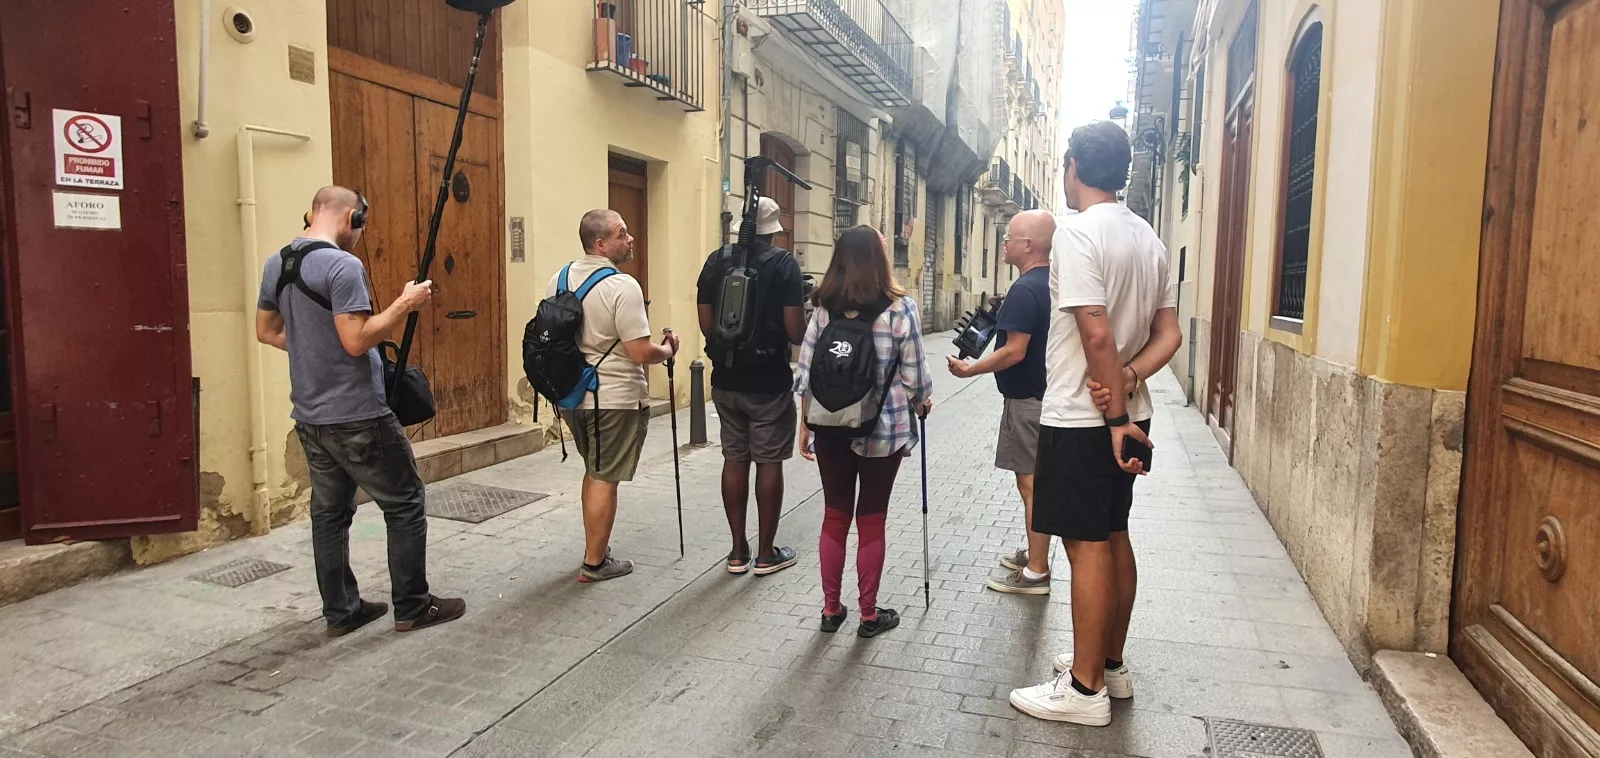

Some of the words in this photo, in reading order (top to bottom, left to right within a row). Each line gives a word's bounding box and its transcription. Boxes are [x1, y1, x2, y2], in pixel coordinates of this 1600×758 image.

[68, 156, 110, 166] PROHIBIDO
[76, 166, 104, 174] FUMAR
[66, 201, 104, 209] AFORO
